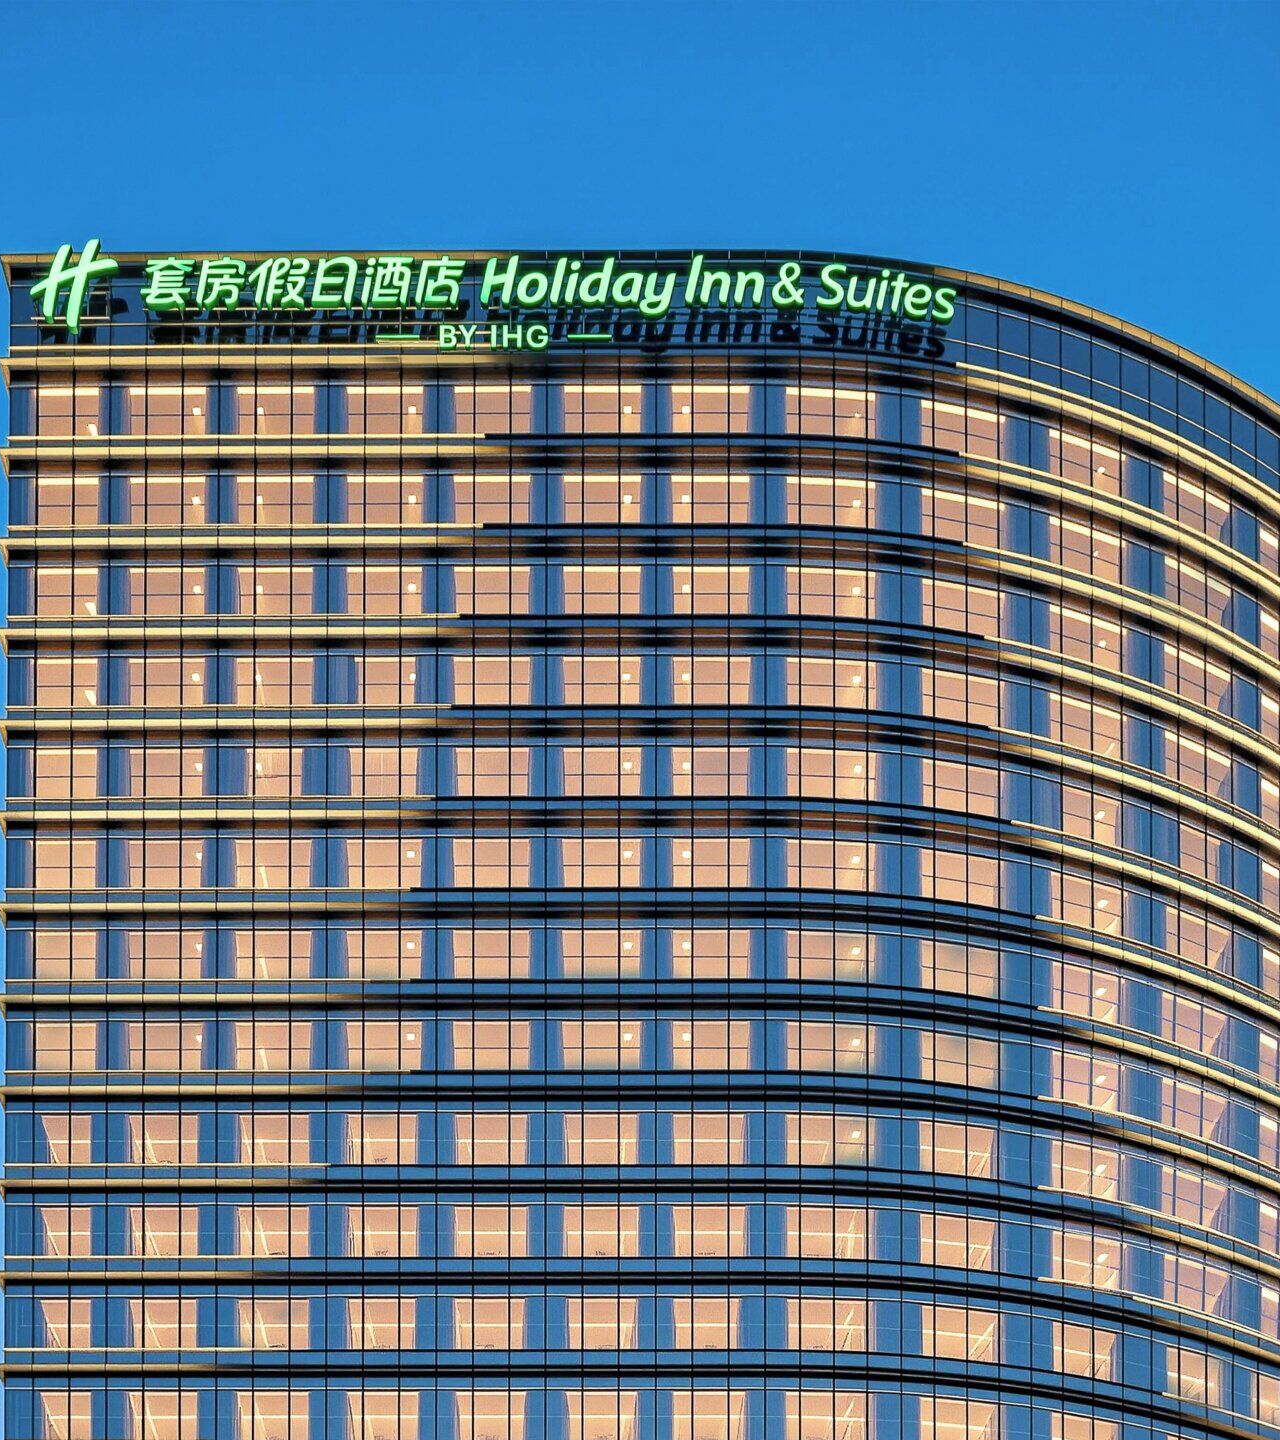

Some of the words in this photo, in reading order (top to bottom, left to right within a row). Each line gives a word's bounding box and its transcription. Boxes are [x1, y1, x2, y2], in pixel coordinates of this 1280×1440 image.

[140, 255, 466, 311] 套房假日酒店
[480, 254, 676, 318] Holiday
[684, 254, 765, 306] Inn
[771, 261, 805, 308] &
[816, 263, 957, 323] Suites
[438, 324, 477, 349] BY
[490, 324, 548, 349] IHG
